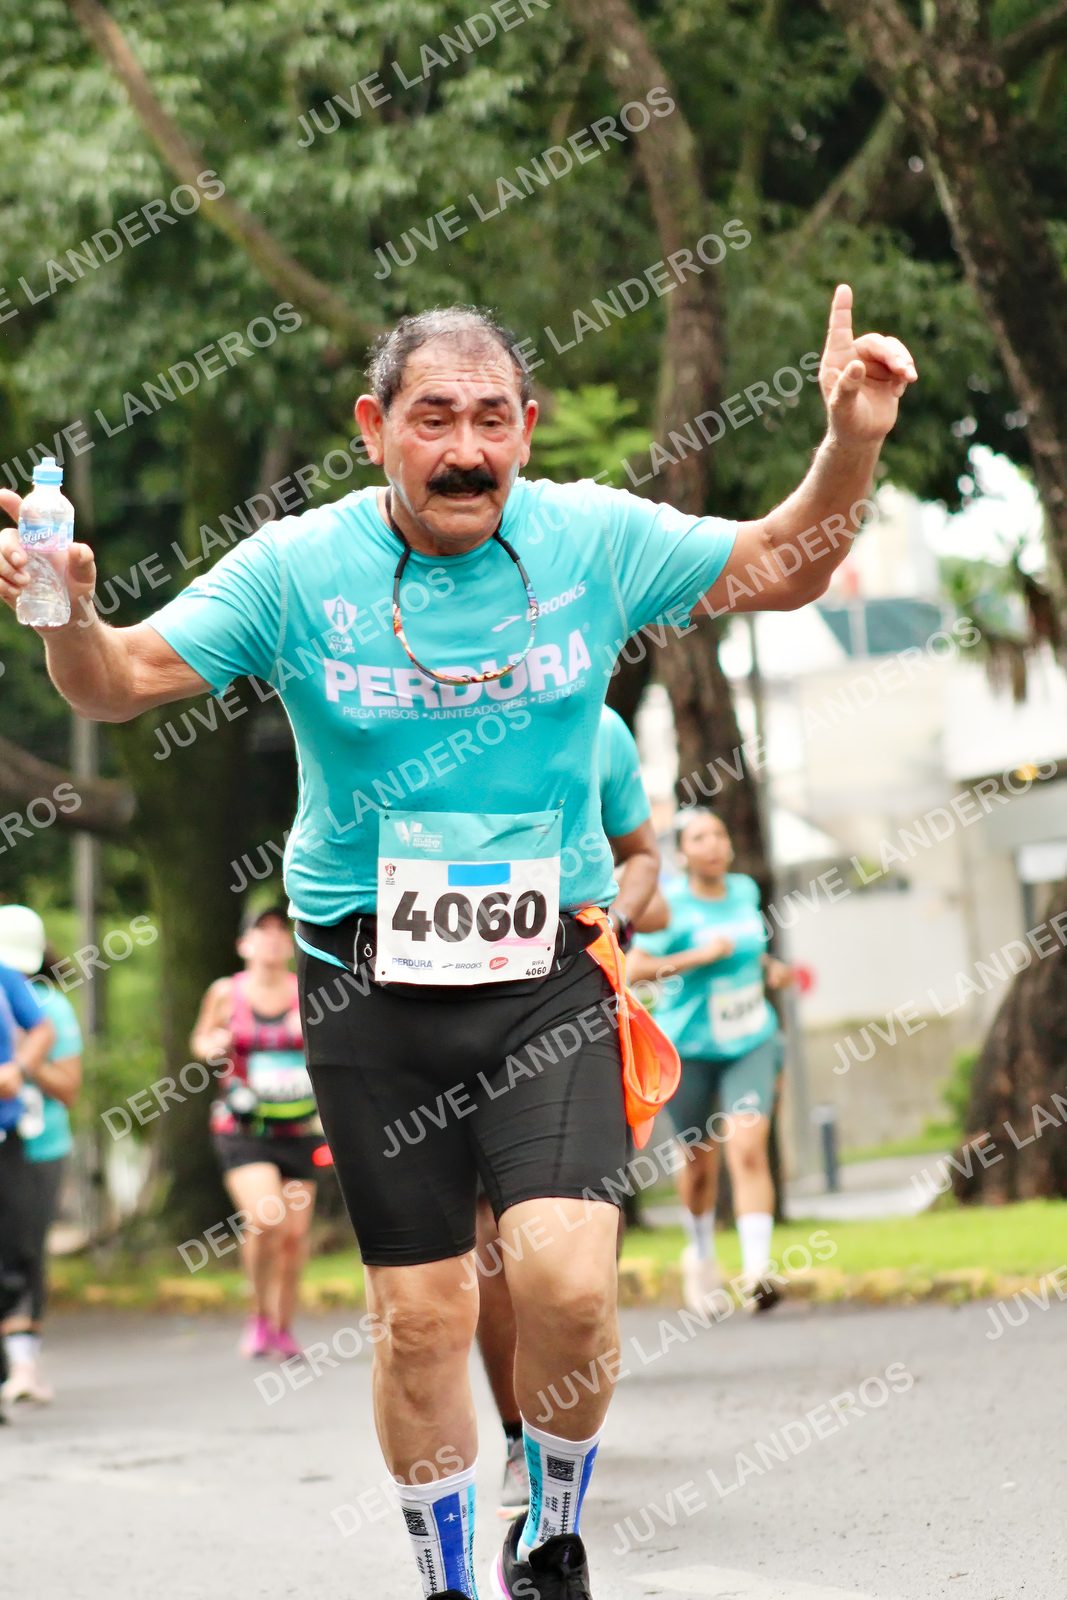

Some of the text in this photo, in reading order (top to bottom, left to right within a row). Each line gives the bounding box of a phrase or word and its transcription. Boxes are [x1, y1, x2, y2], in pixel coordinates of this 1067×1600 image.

[324, 628, 592, 708] PERDURA
[343, 707, 376, 719] PEGA
[378, 708, 419, 720] PISOS
[392, 890, 547, 943] 4060
[391, 957, 433, 968] PERDURA
[455, 962, 482, 970] BROOKS
[525, 966, 547, 976] 4060
